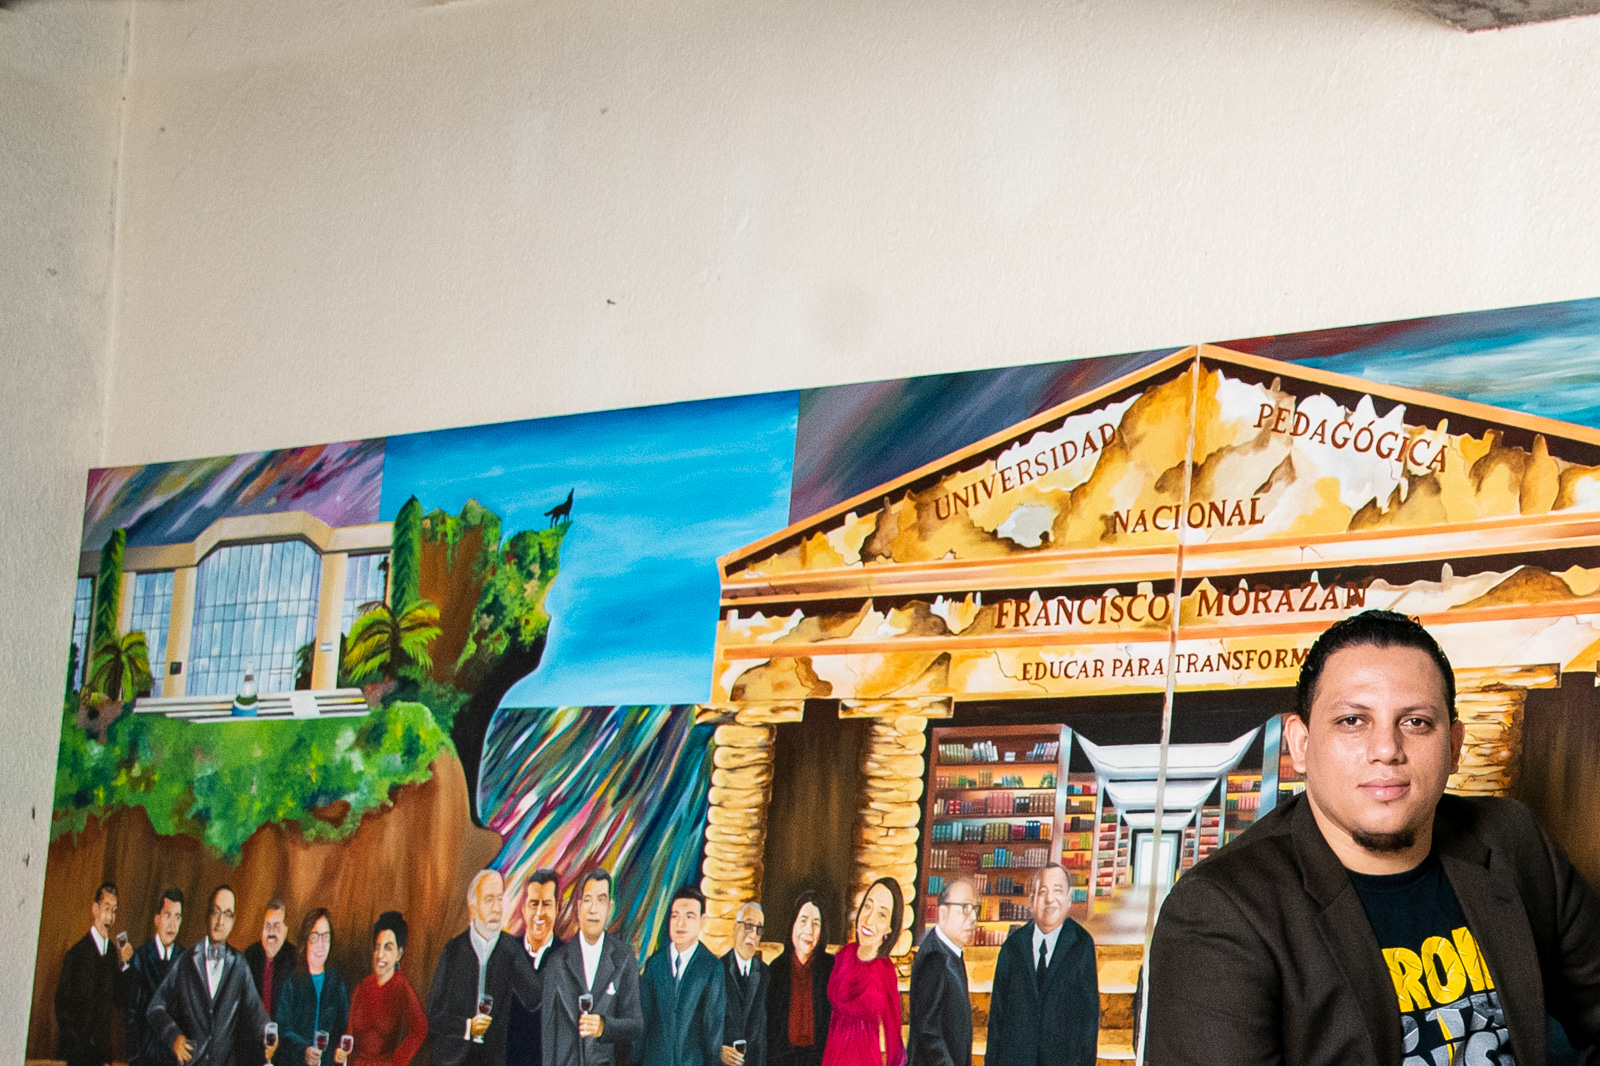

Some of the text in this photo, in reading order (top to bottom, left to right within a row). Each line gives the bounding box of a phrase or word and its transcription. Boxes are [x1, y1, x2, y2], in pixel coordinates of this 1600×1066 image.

[934, 403, 1448, 522] UNIVERSIDAD PEDAGÓGICA
[1112, 496, 1265, 535] NACIONAL
[994, 573, 1374, 630] FRANCISCO MORAZÁN
[1022, 647, 1310, 682] EDUCAR PARA TRANSFORM
